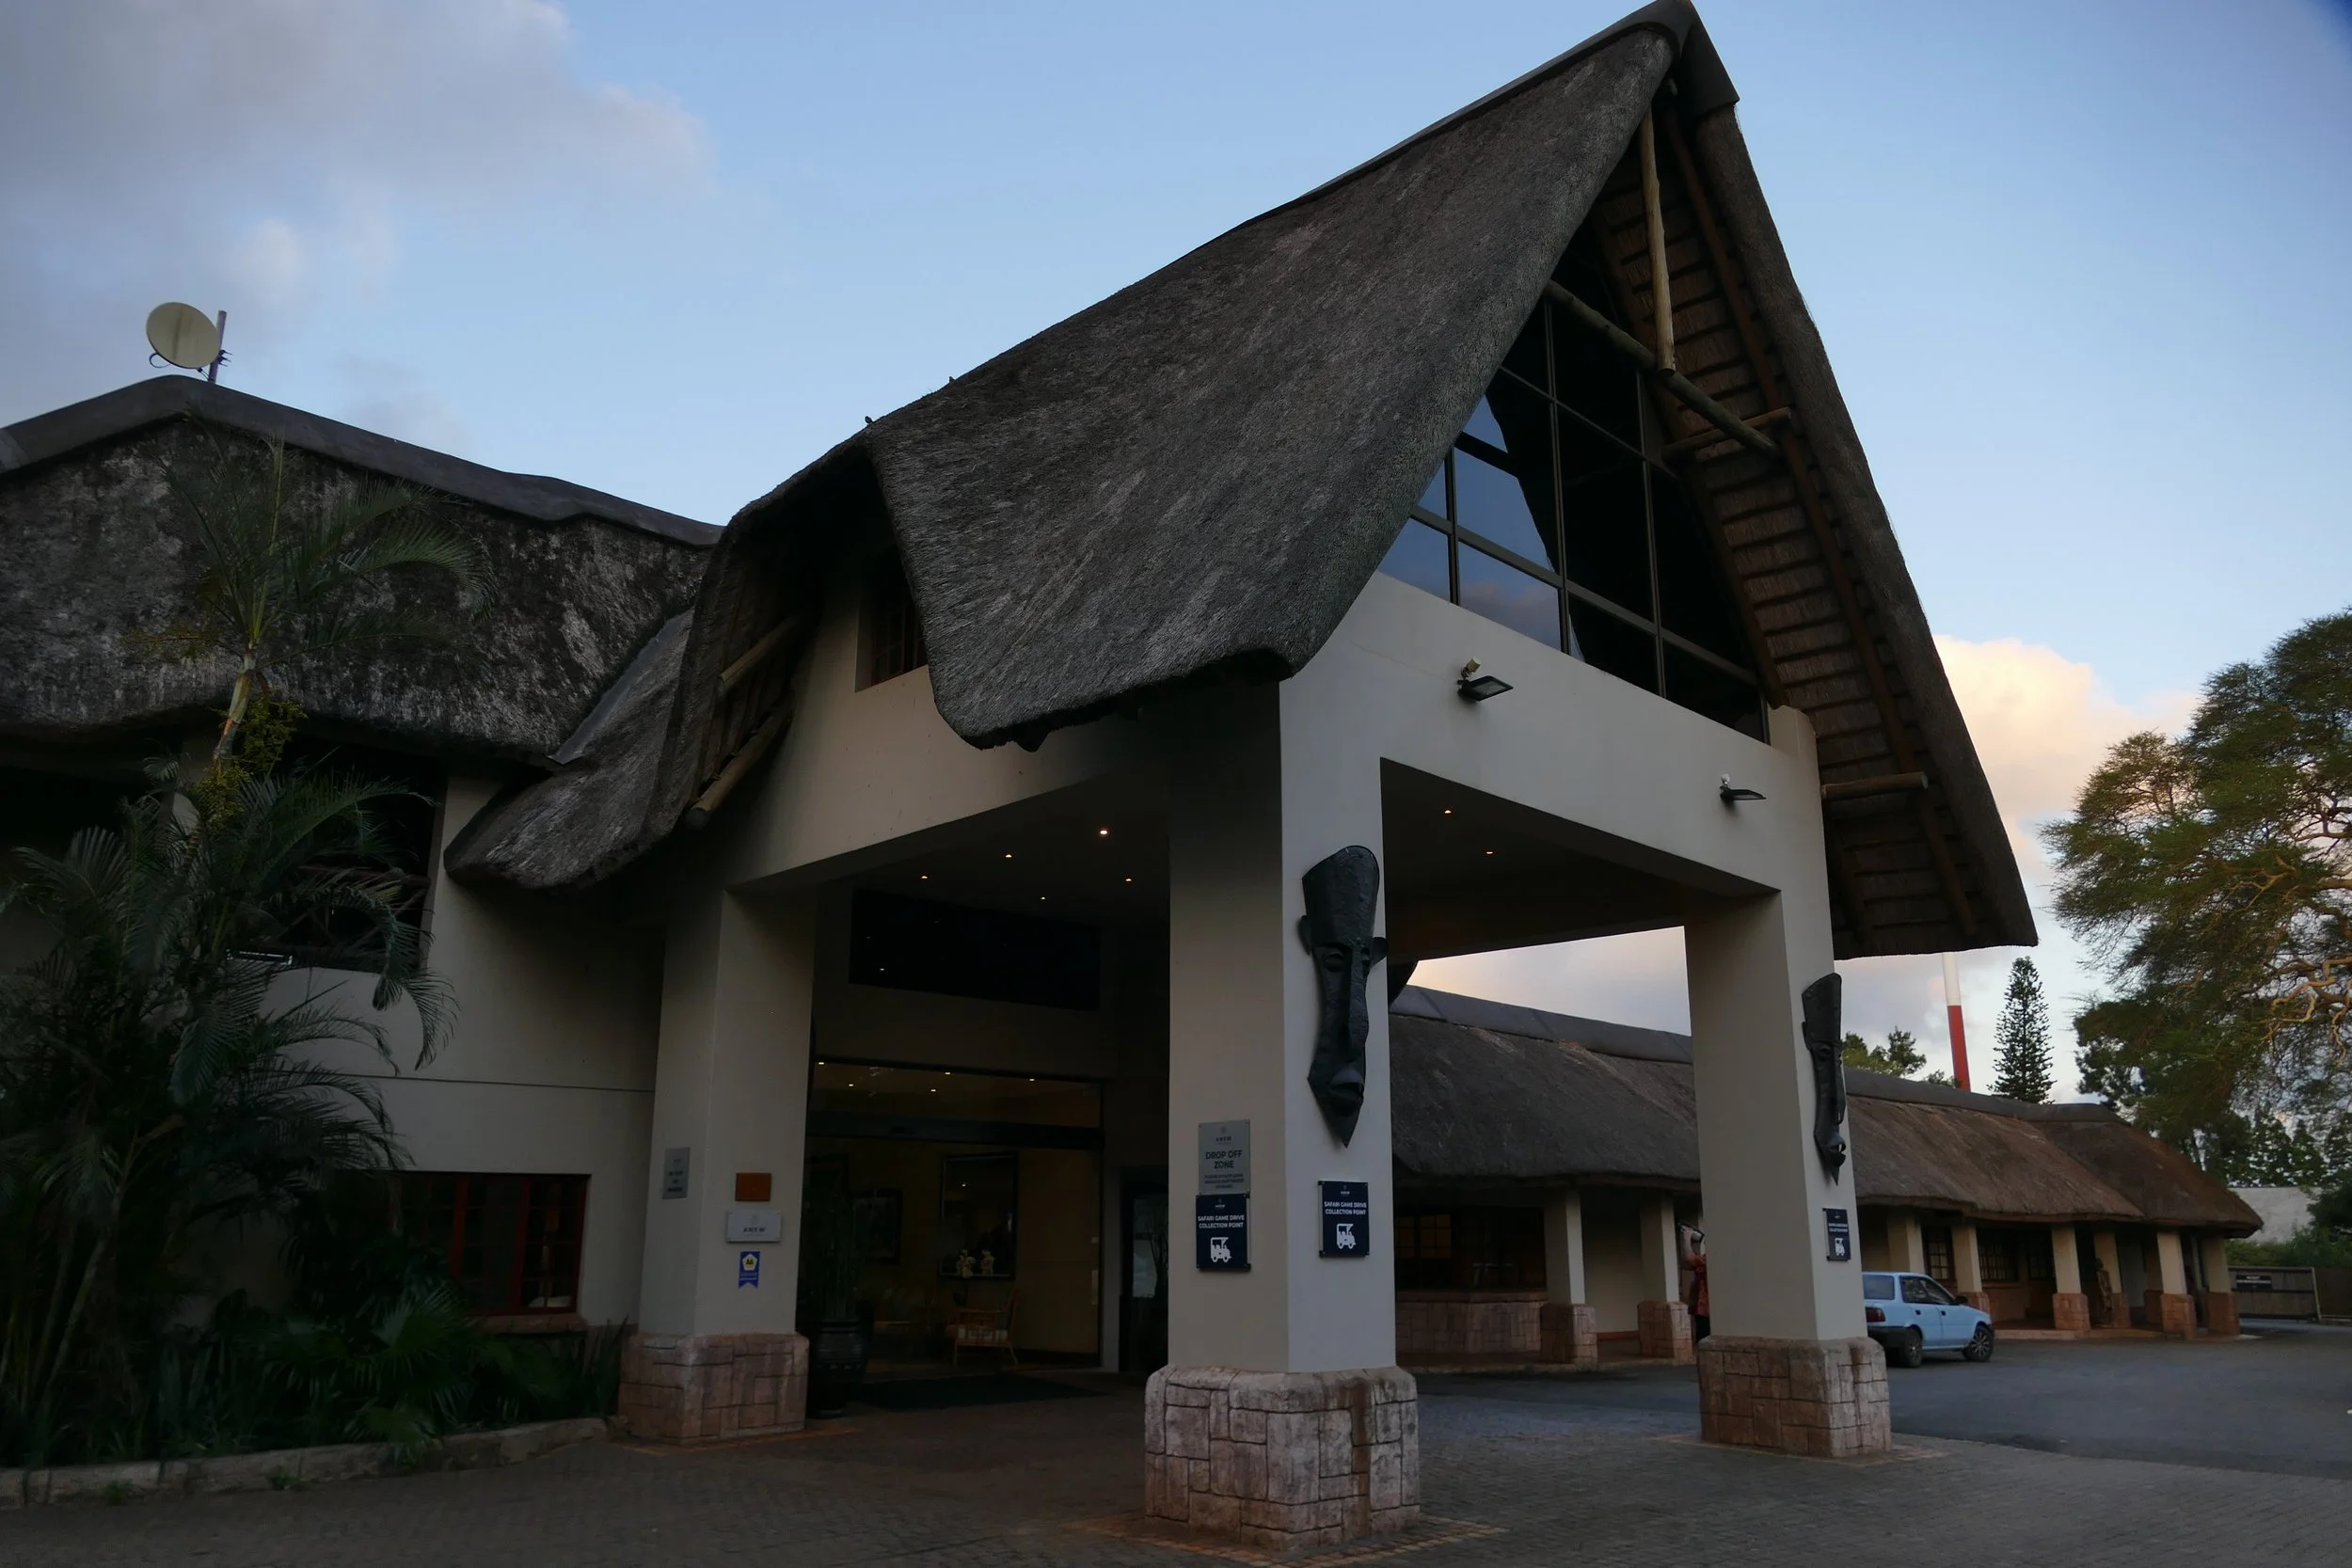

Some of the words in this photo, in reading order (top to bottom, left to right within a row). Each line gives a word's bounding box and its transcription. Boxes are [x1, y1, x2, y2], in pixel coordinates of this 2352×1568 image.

[1206, 1151, 1227, 1160] DROP
[1228, 1149, 1242, 1158] OFF
[1215, 1160, 1234, 1169] ZONE
